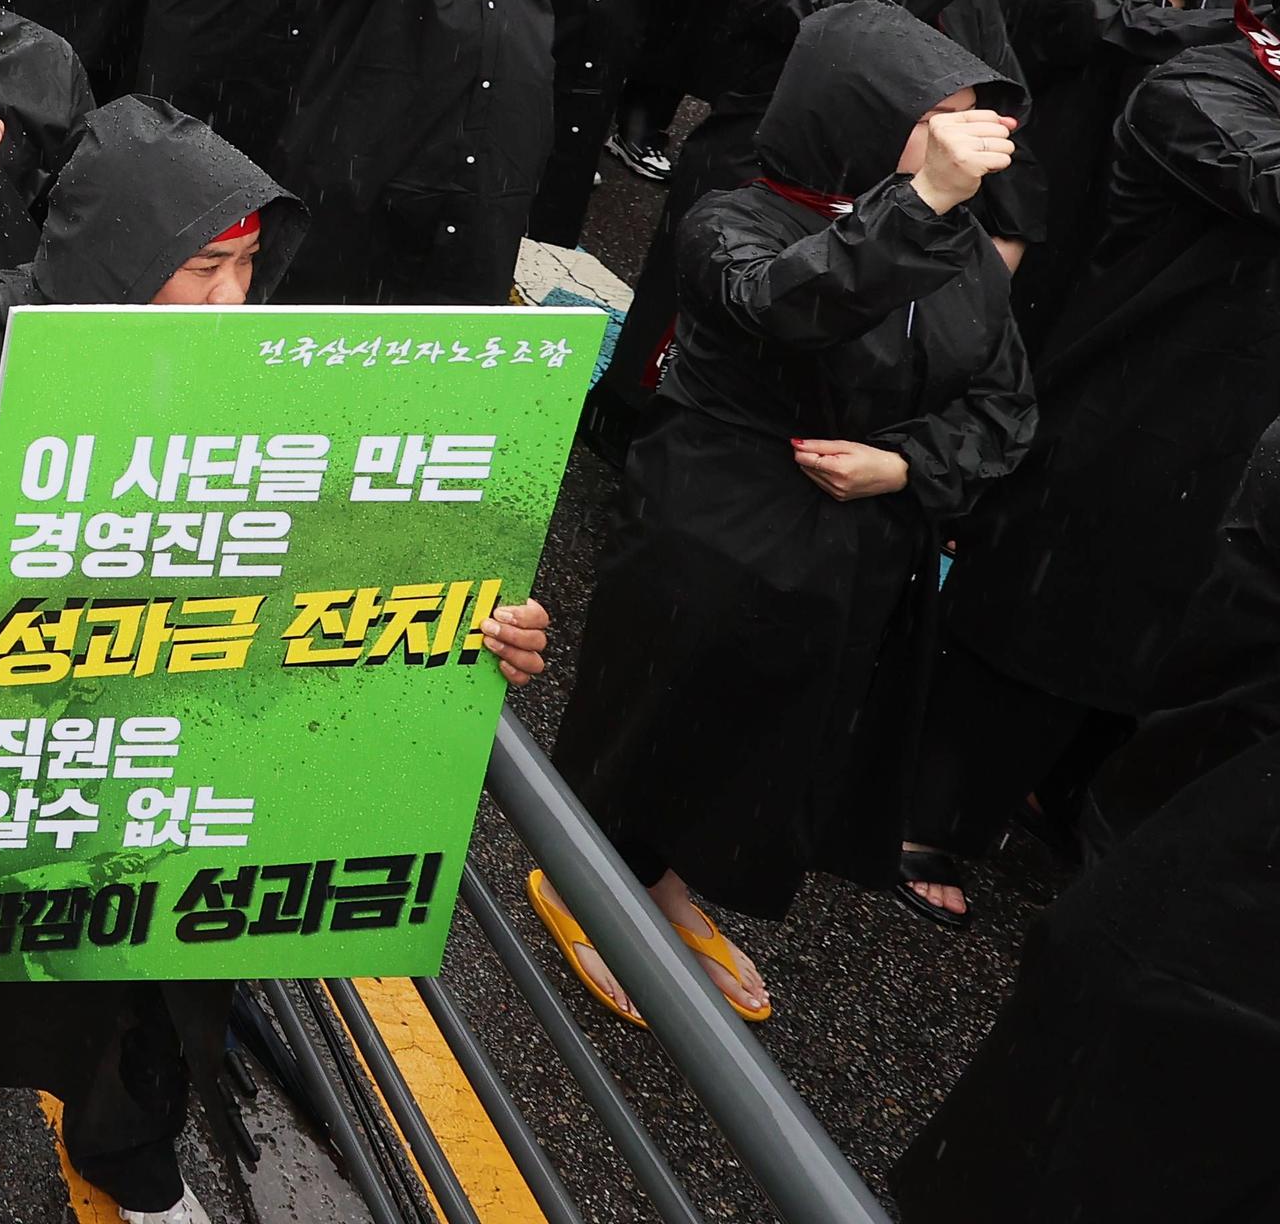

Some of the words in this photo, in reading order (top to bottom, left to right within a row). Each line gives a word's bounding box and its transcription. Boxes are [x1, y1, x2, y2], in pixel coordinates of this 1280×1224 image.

[258, 335, 574, 369] 전국삼성전자노동조합
[19, 434, 95, 502] 이
[110, 432, 332, 503] 사단을
[348, 433, 497, 502] 만든
[9, 509, 293, 579] 경영진은
[280, 579, 503, 670] 잔치!
[123, 785, 255, 849] 없는
[171, 851, 444, 944] 성과금!
